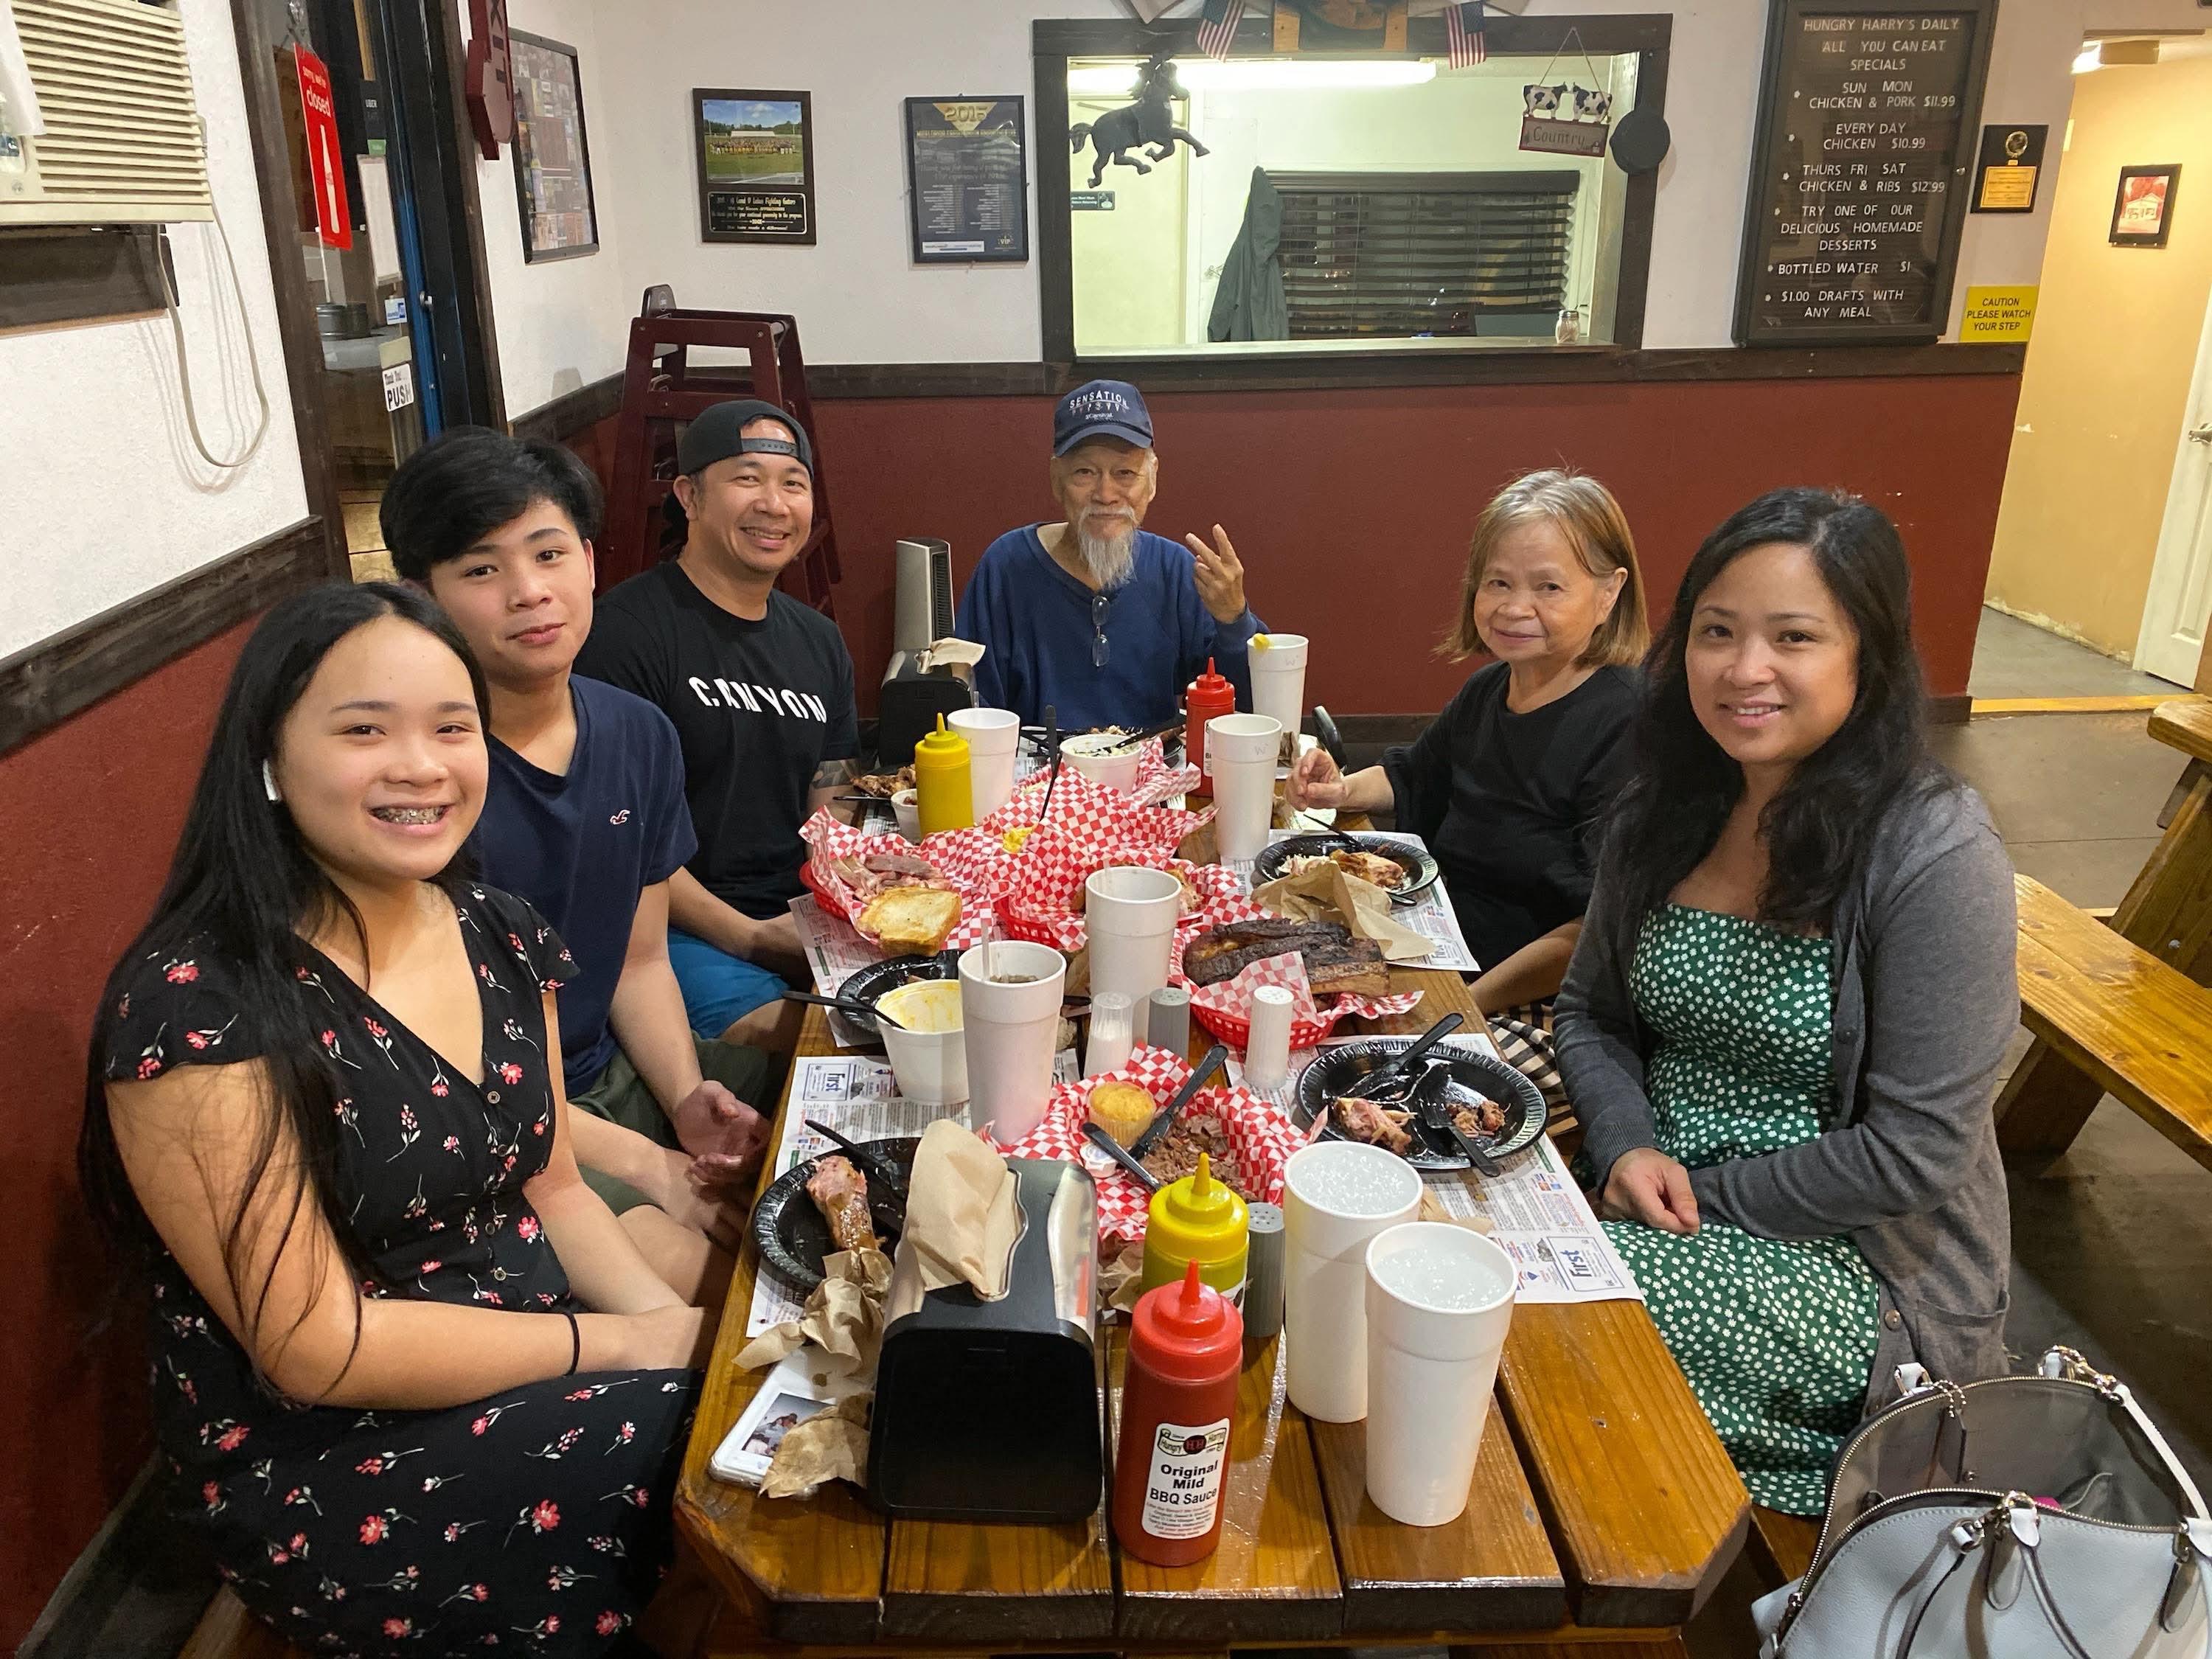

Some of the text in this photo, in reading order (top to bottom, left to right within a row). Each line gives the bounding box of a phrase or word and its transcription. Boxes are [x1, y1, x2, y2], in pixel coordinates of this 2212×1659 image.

[1804, 18, 1960, 31] HUNGRY HARRY'S DAILY
[1822, 40, 1947, 52] ALL YOU CAN EAT
[1850, 58, 1906, 71] SPECIALS
[1843, 81, 1913, 94] SUN MON
[306, 85, 331, 118] closed
[1809, 95, 1955, 109] CHICKEN & PORK $11.99
[944, 105, 988, 122] 2015
[1835, 122, 1907, 135] EVERY DAY
[1534, 126, 1585, 149] Country
[1823, 137, 1926, 150] CHICKEN $10.99
[1802, 163, 1907, 176] THURS FRI SAT
[1798, 179, 1946, 193] CHICKEN & RIBS $12.99
[1801, 204, 1913, 218] TRY ONE OF OUR
[1780, 220, 1924, 235] DELICIOUS HOMEMADE
[1818, 239, 1877, 251] DESSERTS
[1778, 260, 1911, 275] BOTTLED WATER $1
[1781, 289, 1905, 303] $1.00 DRAFTS WITH
[1982, 297, 2020, 307] CAUTION
[1804, 306, 1872, 319] ANY MEAL
[1966, 309, 2031, 319] PLEASE WATCH
[1973, 321, 2021, 331] YOUR STEP
[386, 382, 413, 411] PUSH
[1069, 389, 1130, 409] SENSATION
[688, 675, 827, 724] CANYON
[1560, 1250, 1591, 1276] first
[1161, 1459, 1219, 1479] Original
[1172, 1477, 1205, 1489] Mild
[1150, 1488, 1217, 1505] BBQ Sauce
